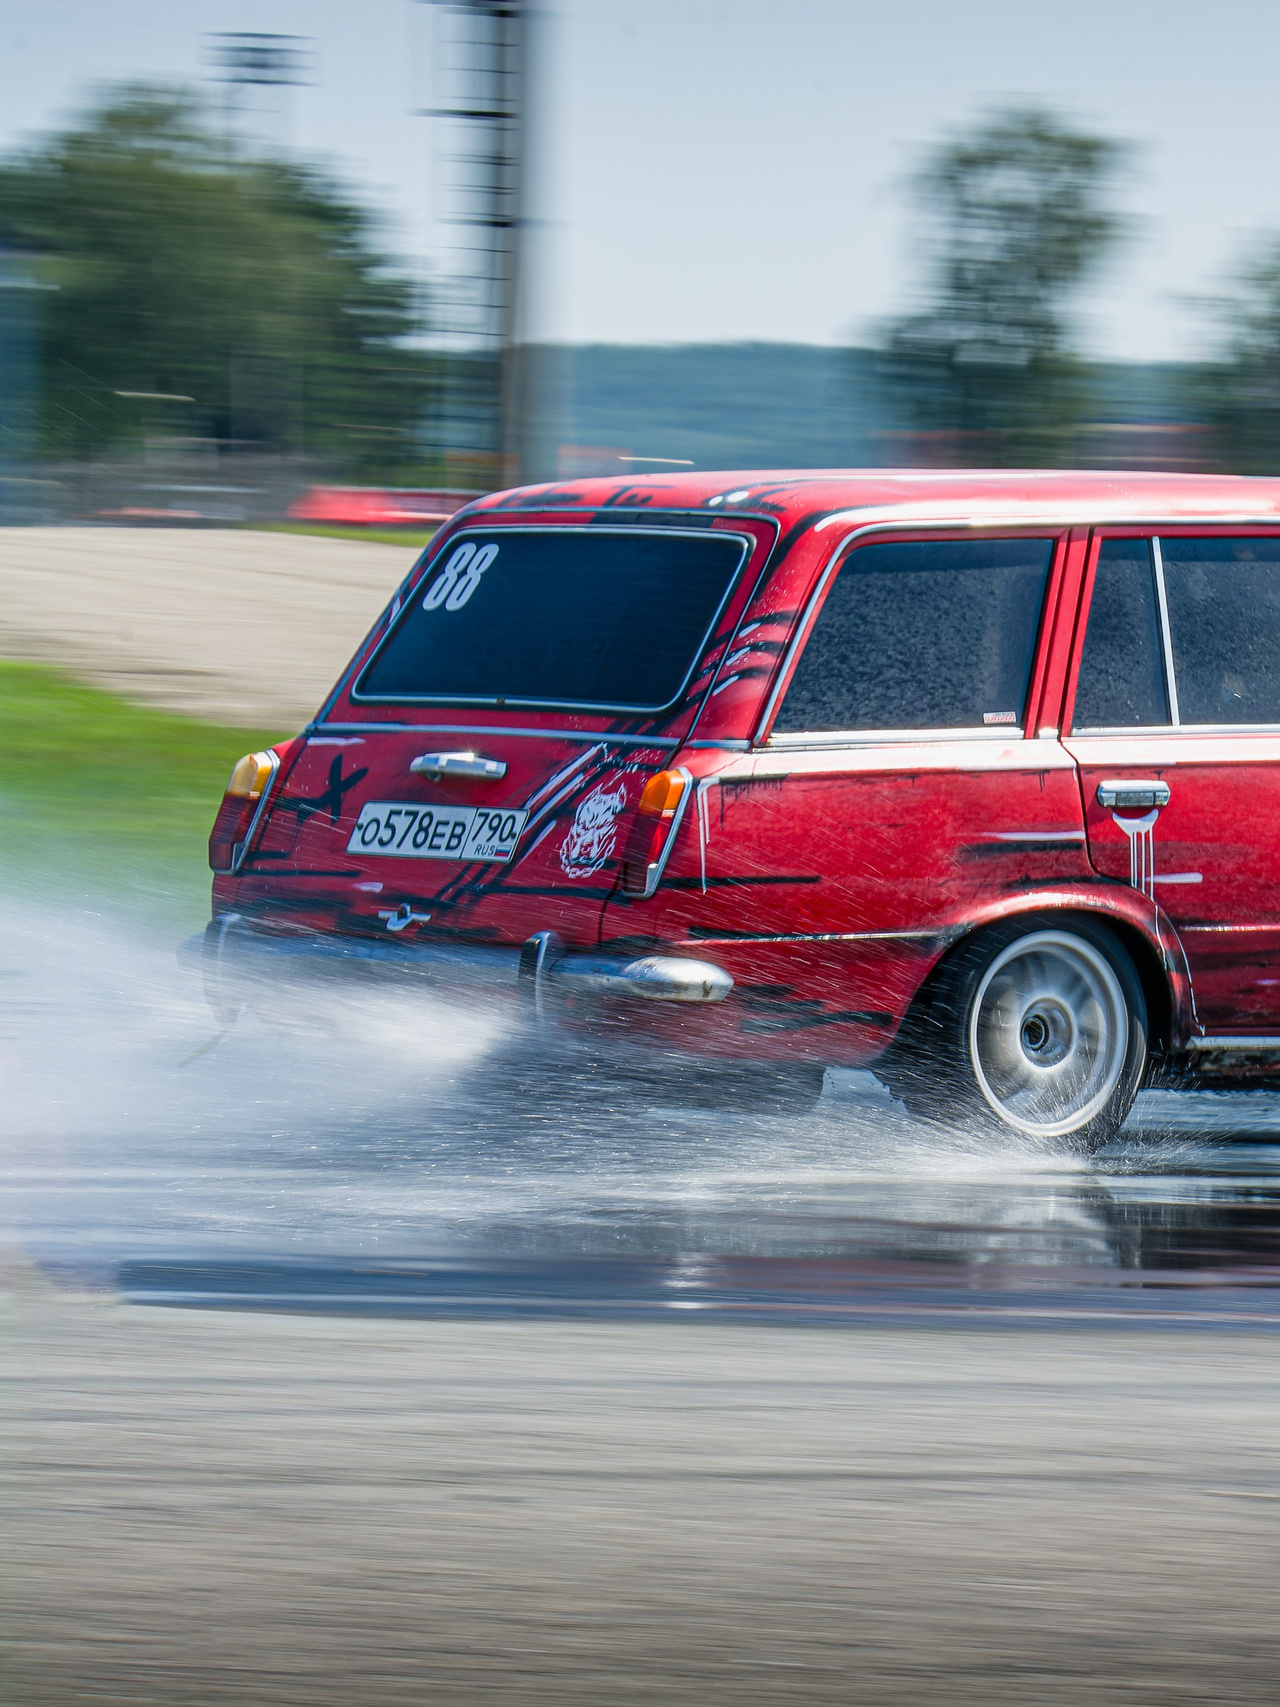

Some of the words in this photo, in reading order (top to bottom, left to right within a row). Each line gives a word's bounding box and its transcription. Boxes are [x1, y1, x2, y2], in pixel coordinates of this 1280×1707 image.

[423, 542, 499, 612] 88
[471, 812, 517, 843] 790
[474, 843, 496, 857] RUS
